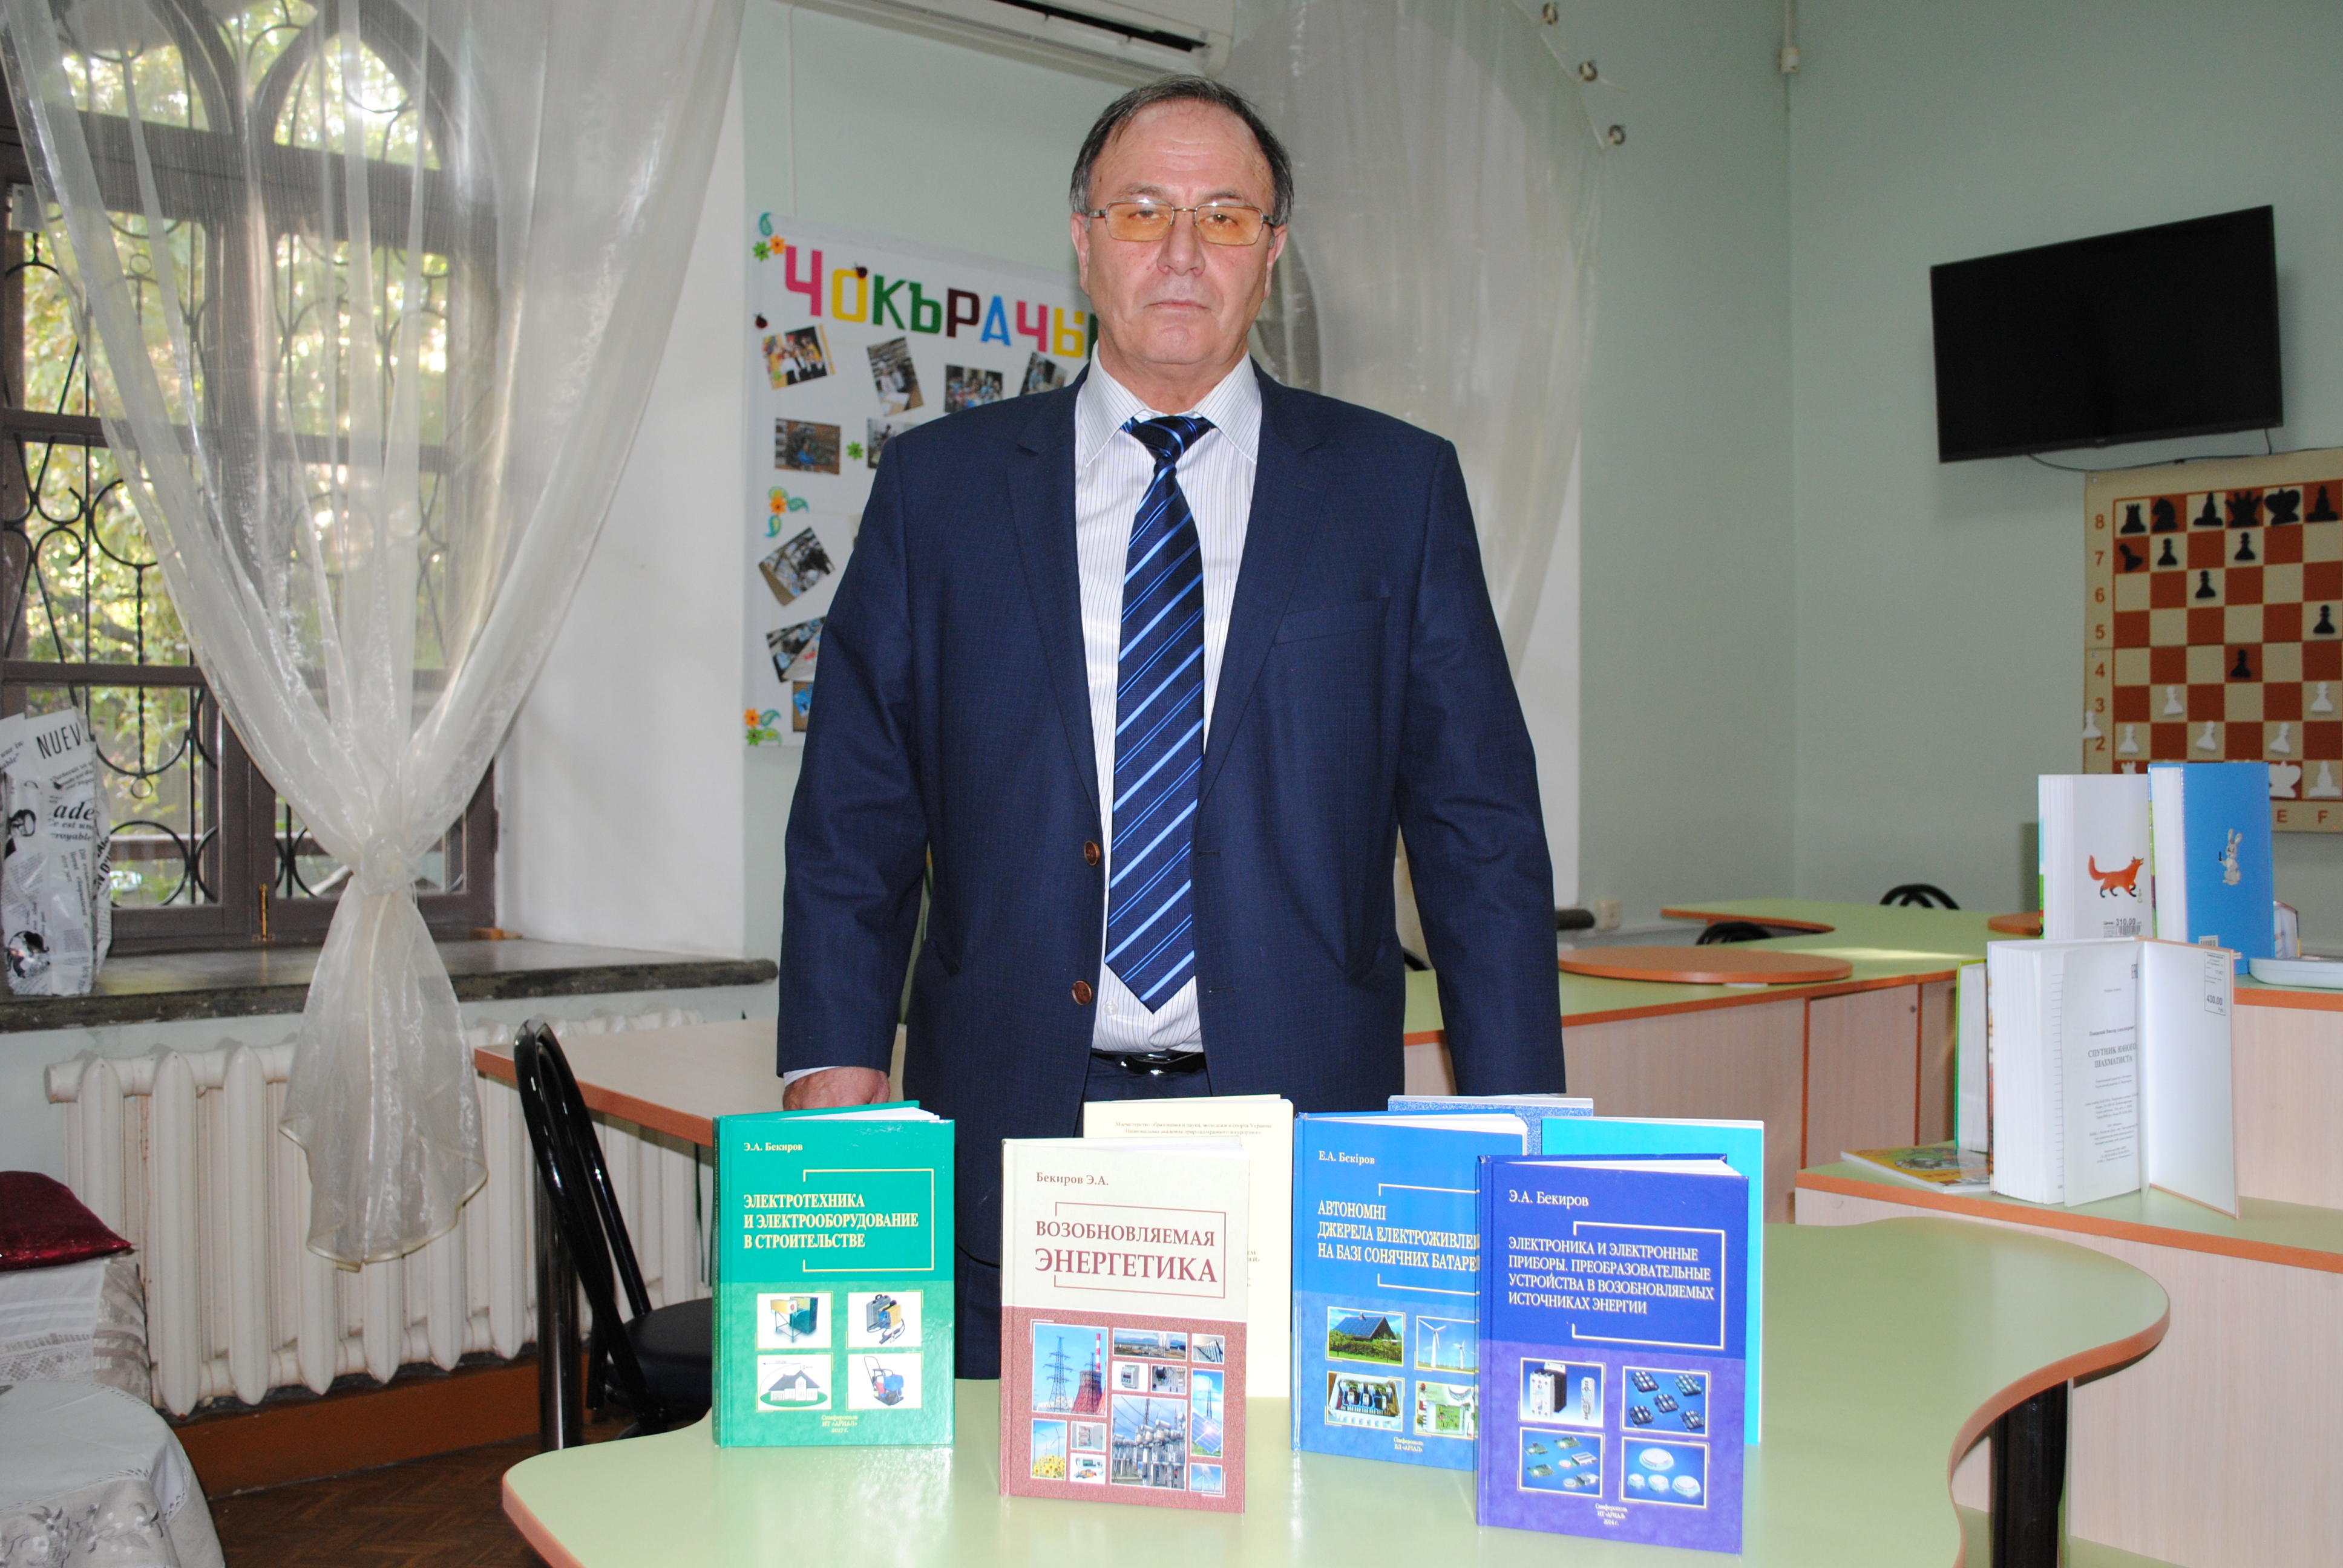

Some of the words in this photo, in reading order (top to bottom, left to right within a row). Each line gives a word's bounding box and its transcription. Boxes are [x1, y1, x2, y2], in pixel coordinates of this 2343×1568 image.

[2096, 514, 2105, 528] 8
[2096, 552, 2105, 565] 7
[2096, 589, 2105, 602] 6
[2096, 625, 2105, 639] 5
[2095, 663, 2105, 677] 4
[2096, 698, 2105, 712] 3
[2096, 737, 2106, 751] 2
[2276, 810, 2288, 823] E
[2318, 811, 2328, 823] F
[2088, 1046, 2117, 1057] СПУТНИК
[2117, 1042, 2137, 1053] ЮНОГО
[2094, 1054, 2132, 1068] ШАХМАТИСТА
[743, 1142, 763, 1151] Э.А.
[765, 1142, 803, 1153] Бекиров
[1318, 1150, 1336, 1161] Е.А.
[1339, 1152, 1375, 1165] Бекіров
[1036, 1172, 1083, 1186] Бекиров
[1086, 1174, 1109, 1186] Э.А.
[744, 1194, 865, 1208] ЭЛЕКТРОТЕХНИКА
[1509, 1189, 1533, 1204] Э.А.
[1536, 1192, 1589, 1209] Бекиров
[1317, 1200, 1386, 1220] АВТОНОМНІ
[744, 1214, 754, 1229] И
[756, 1212, 919, 1230] ЭЛЕКТРООБОРУДОВАНИЕ
[1035, 1220, 1215, 1247] ВОЗОБНОВЛЯЕМАЯ
[1317, 1221, 1374, 1241] ДЖЕРЕЛА
[743, 1234, 753, 1249] В
[755, 1233, 866, 1249] СТРОИТЕЛЬСТВЕ
[1509, 1236, 1594, 1255] ЭЛЕКТРОНИКА
[1597, 1243, 1607, 1255] И
[1609, 1243, 1699, 1261] ЭЛЕКТРОННЫЕ
[1035, 1247, 1218, 1282] ЭНЕРГЕТИКА
[1317, 1242, 1334, 1258] НА
[1336, 1244, 1362, 1261] БАЗІ
[1364, 1247, 1429, 1268] СОНЯЧНИХ
[1432, 1253, 1477, 1272] БАТАРЕ
[1509, 1255, 1568, 1272] ПРИБОРЫ.
[1571, 1259, 1711, 1281] ПРЕОБРАЗОВАТЕЛЬНЫЕ
[1509, 1272, 1585, 1292] УСТРОЙСТВА
[1587, 1279, 1596, 1292] В
[1598, 1279, 1714, 1301] ВОЗОБНОВЛЯЕМЫХ
[1509, 1292, 1590, 1310] ИСТОЧНИКАХ
[1592, 1299, 1647, 1314] ЭНЕРГИИ
